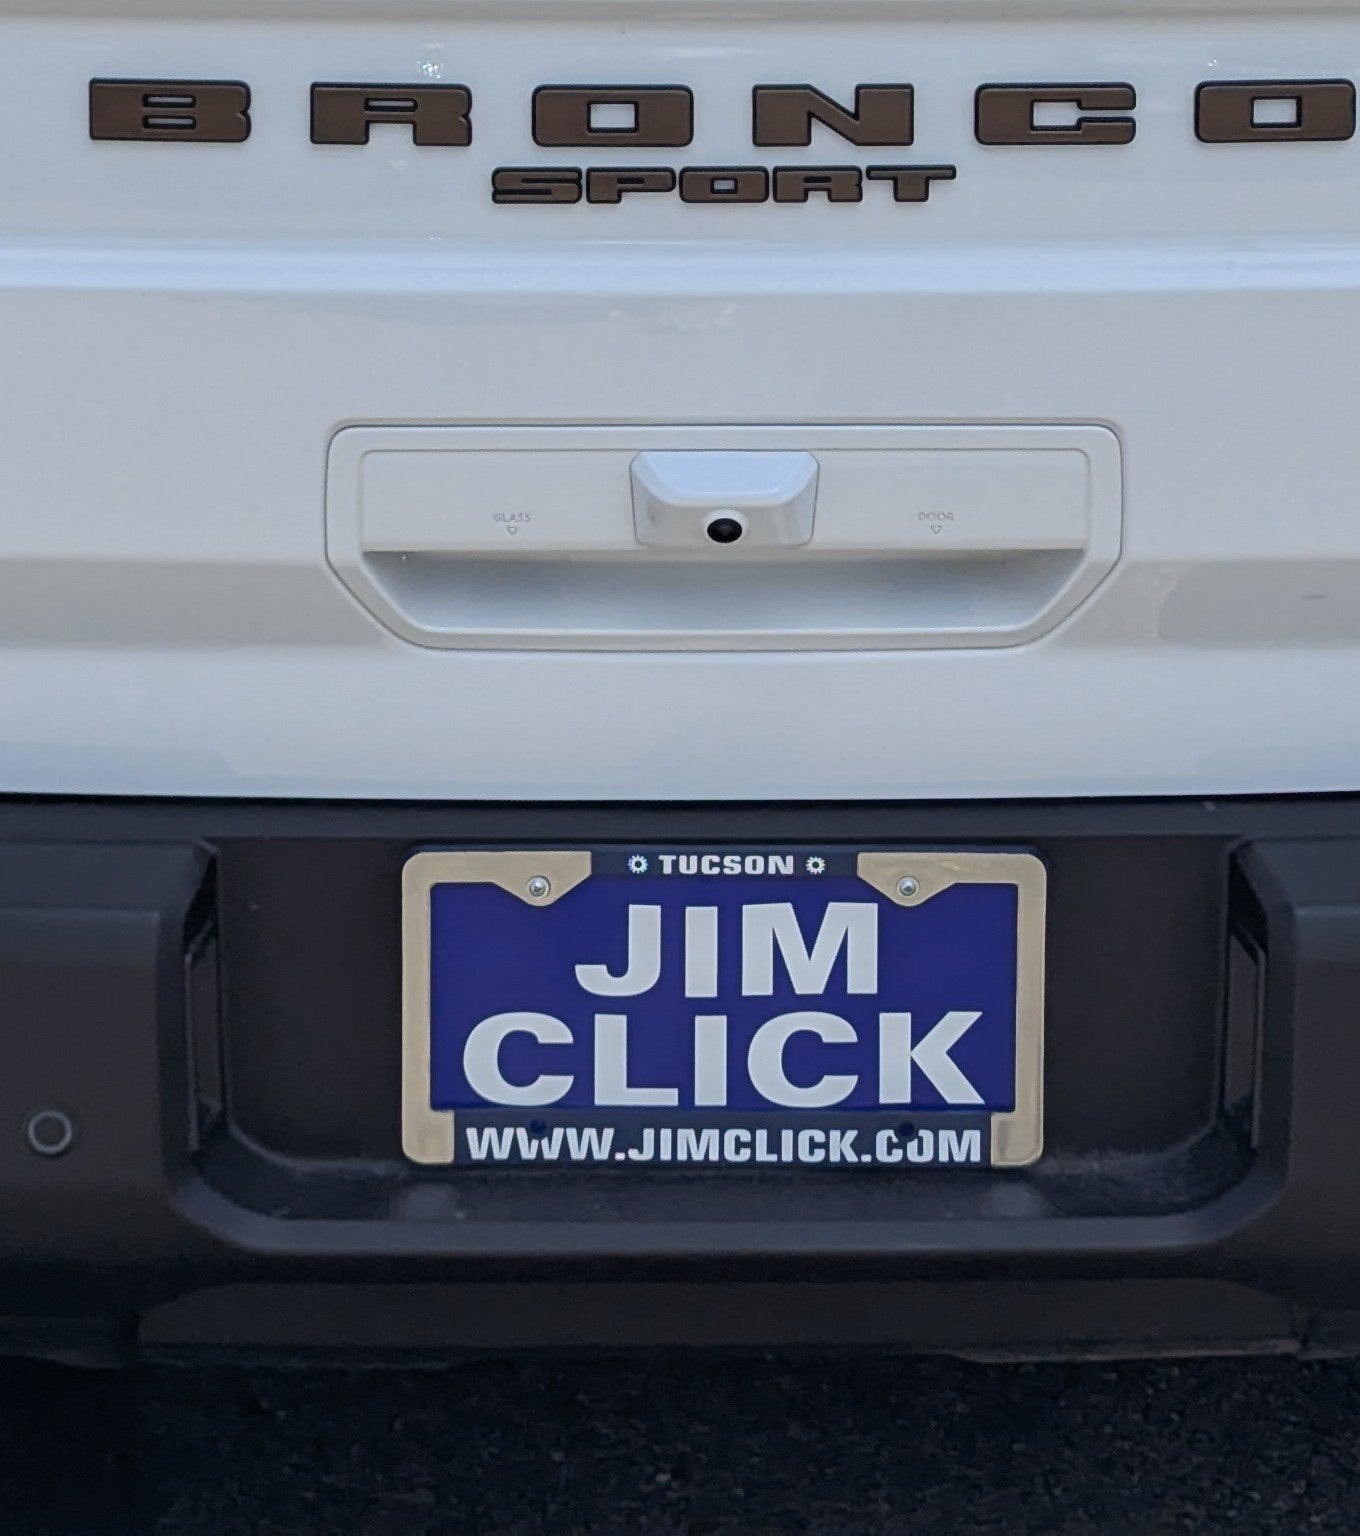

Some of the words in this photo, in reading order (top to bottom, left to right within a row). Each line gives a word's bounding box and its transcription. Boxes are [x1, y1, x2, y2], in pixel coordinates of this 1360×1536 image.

[89, 78, 1356, 147] BRONCO
[491, 164, 957, 204] SPORT
[658, 854, 795, 876] TUCSON
[574, 902, 878, 998] JIM
[462, 1011, 985, 1108] CLICK
[465, 1127, 982, 1164] WWW.JIMCLICK.COM
